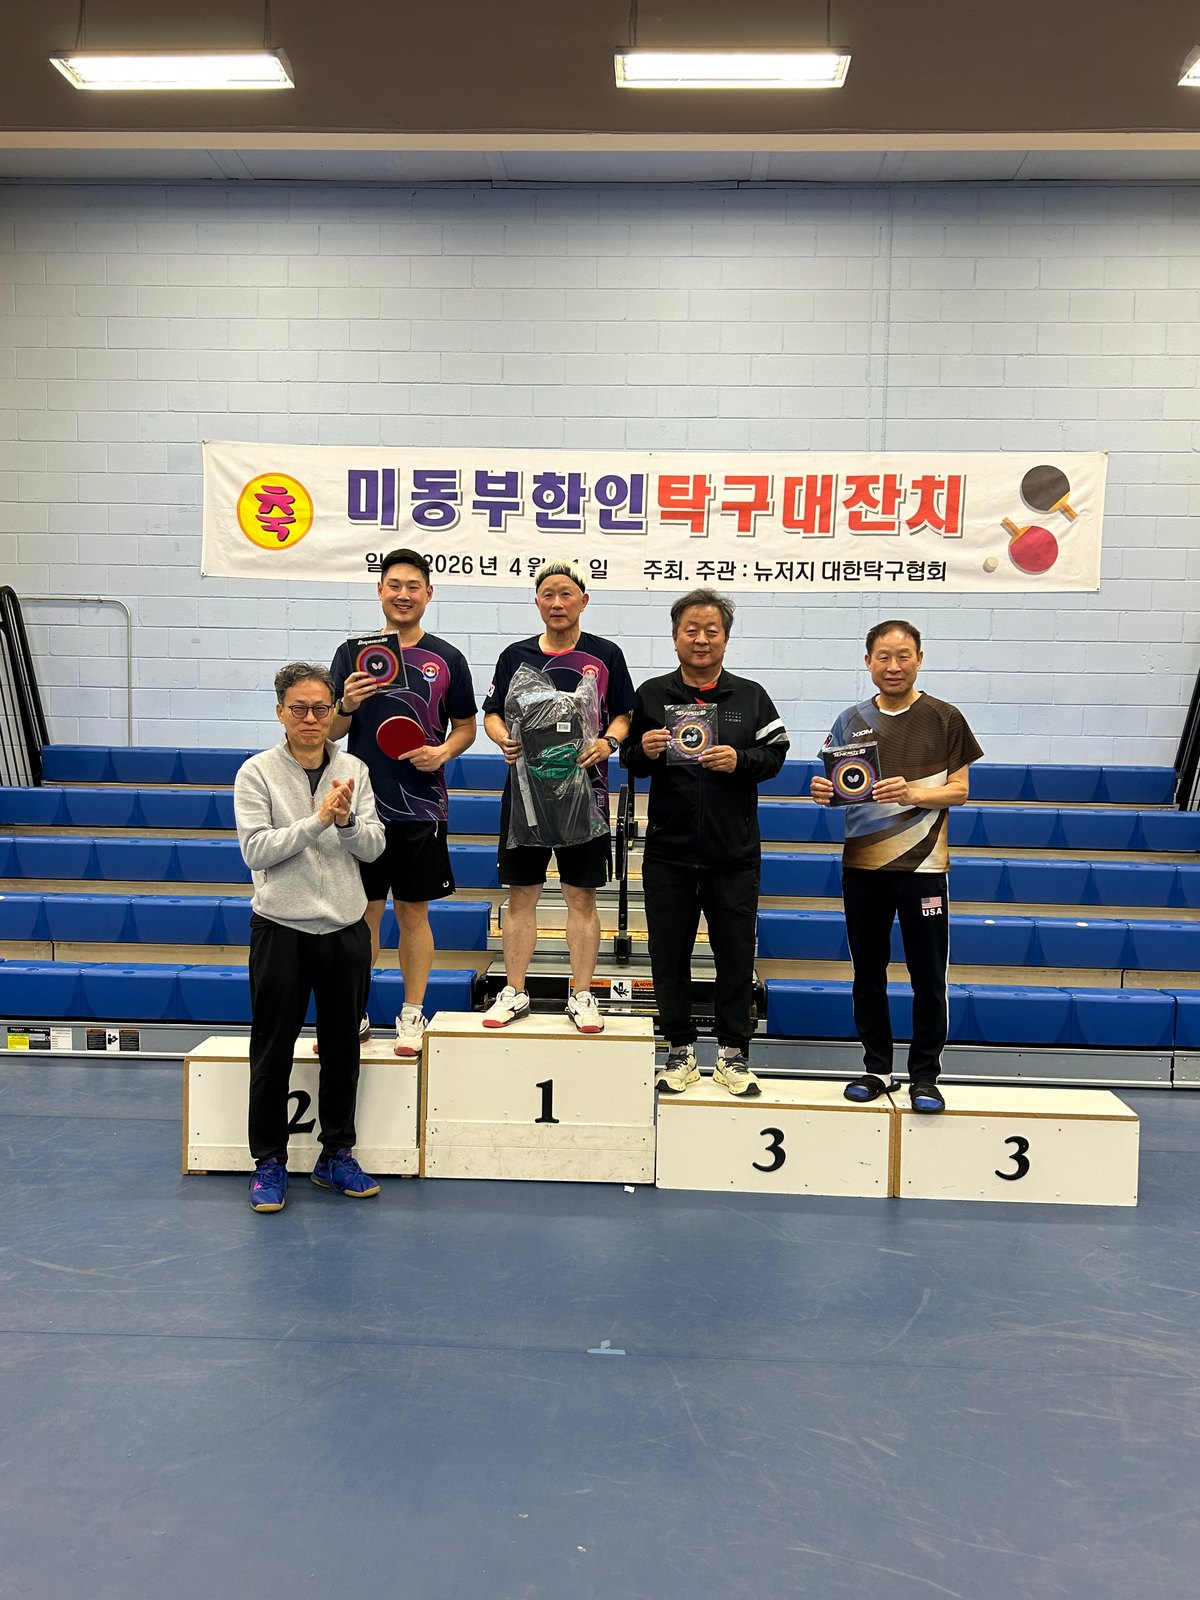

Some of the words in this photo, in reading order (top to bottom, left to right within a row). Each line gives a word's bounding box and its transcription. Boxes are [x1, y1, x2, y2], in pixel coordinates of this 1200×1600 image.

[254, 485, 297, 542] 축
[753, 560, 814, 582] 뉴저지
[821, 560, 947, 582] 대한탁구협회
[852, 728, 874, 738] XIOM
[922, 907, 943, 917] USA
[287, 1090, 317, 1135] 2
[535, 1078, 560, 1124] 1
[752, 1127, 787, 1173] 3
[994, 1135, 1031, 1181] 3
